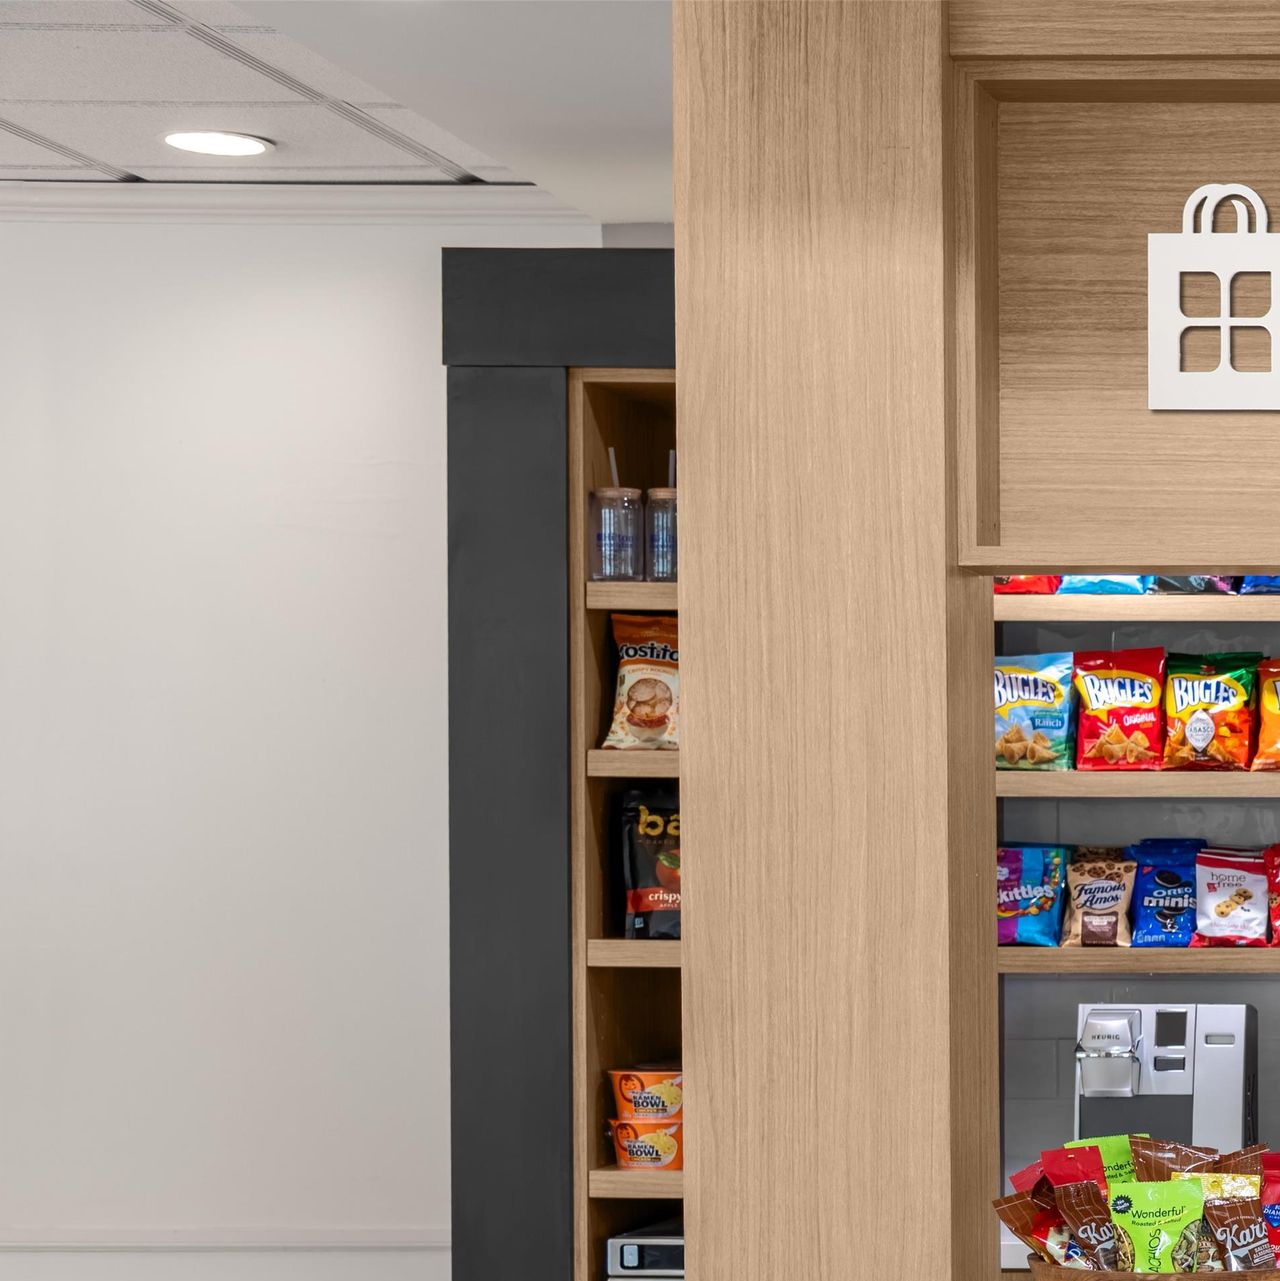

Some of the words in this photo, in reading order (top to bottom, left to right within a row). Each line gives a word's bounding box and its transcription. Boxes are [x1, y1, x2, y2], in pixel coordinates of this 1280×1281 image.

[993, 670, 1056, 707] BUGLES
[1083, 674, 1152, 710] BUGLES
[1172, 677, 1237, 713] BUGLES
[1035, 717, 1061, 729] Ranch
[1211, 871, 1246, 882] home
[1073, 882, 1126, 898] Famous
[1153, 887, 1192, 897] OREO
[1144, 894, 1197, 909] minis
[1131, 1206, 1184, 1219] Wonderful
